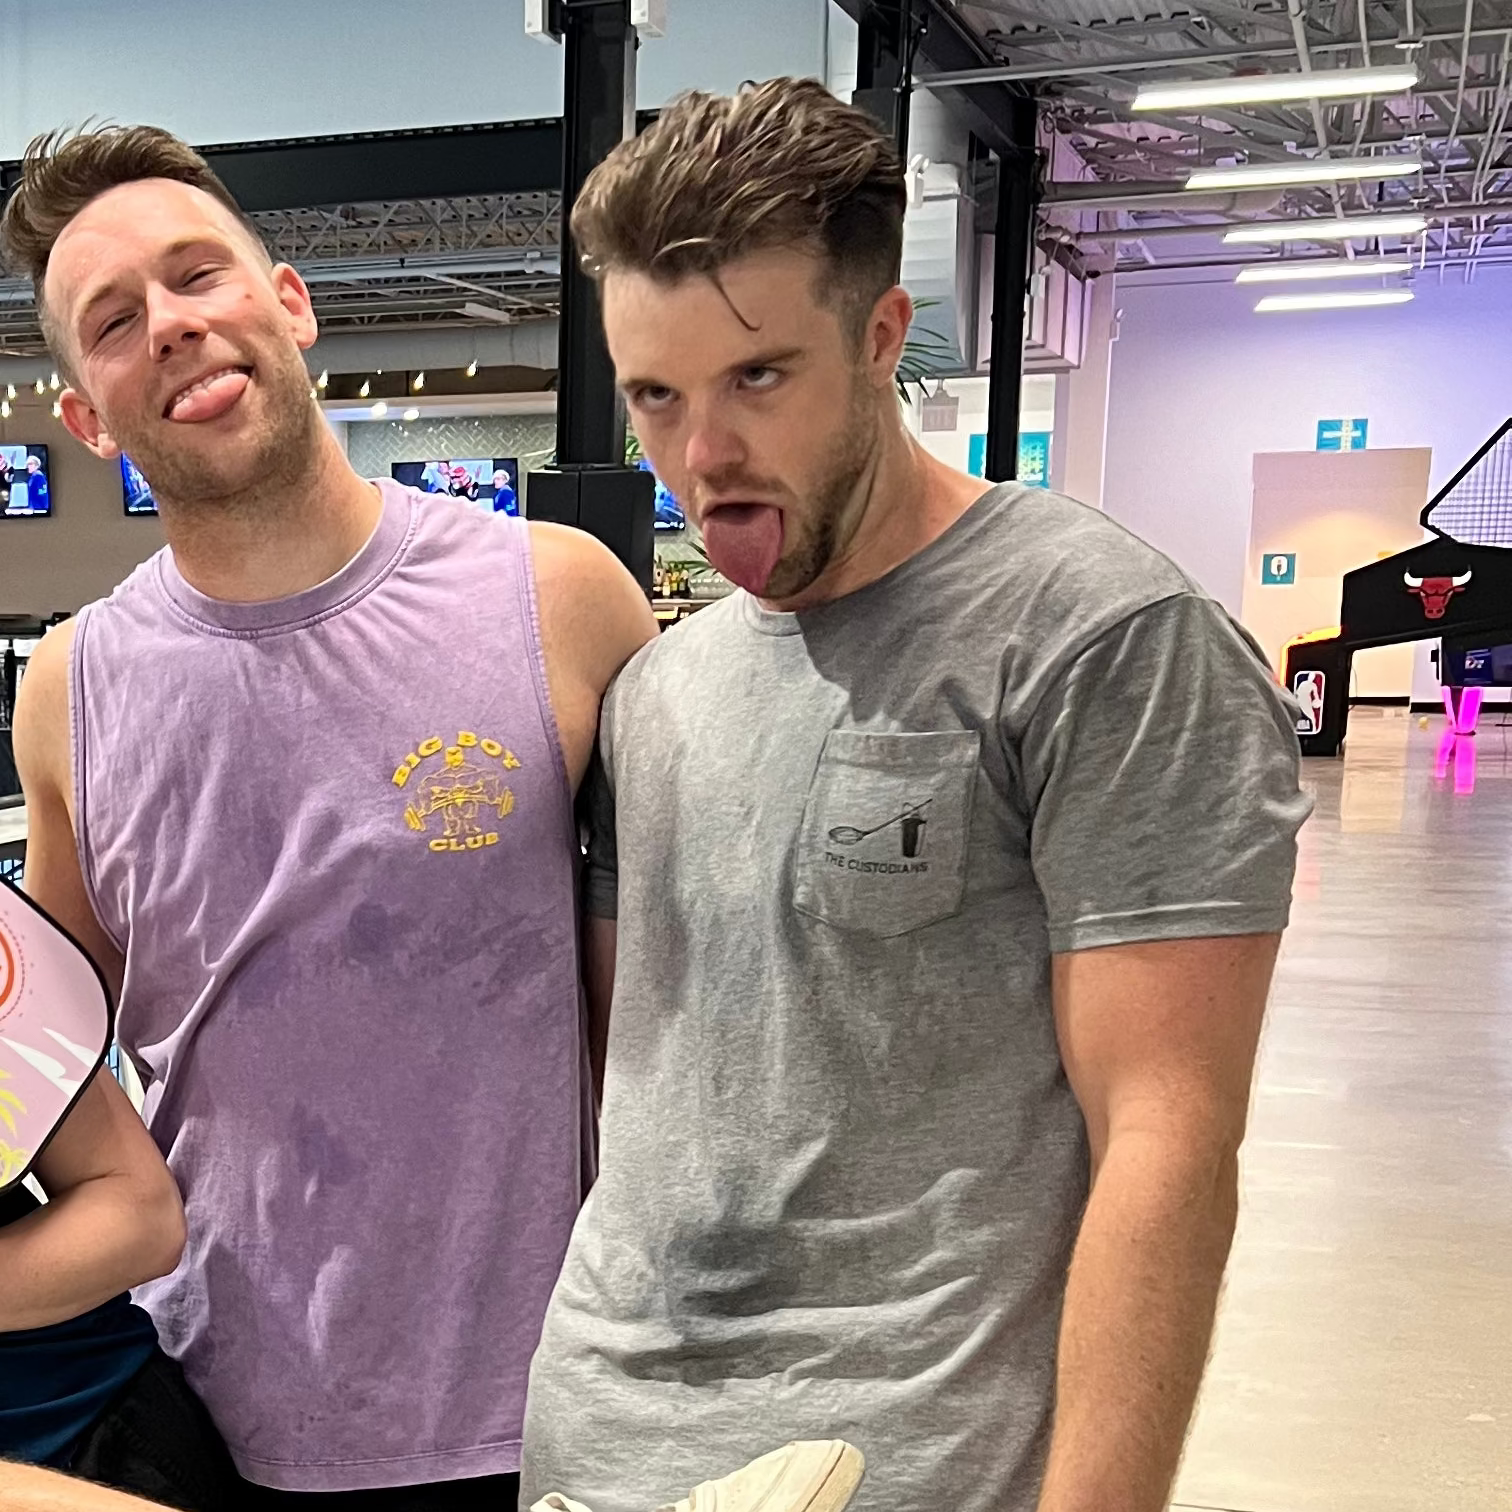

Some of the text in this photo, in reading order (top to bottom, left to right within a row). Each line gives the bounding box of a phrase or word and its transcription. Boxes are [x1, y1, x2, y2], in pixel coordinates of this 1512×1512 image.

[392, 731, 521, 788] BIG BOY
[429, 832, 500, 851] CLUB
[825, 852, 928, 874] THE CUSTODIANS
